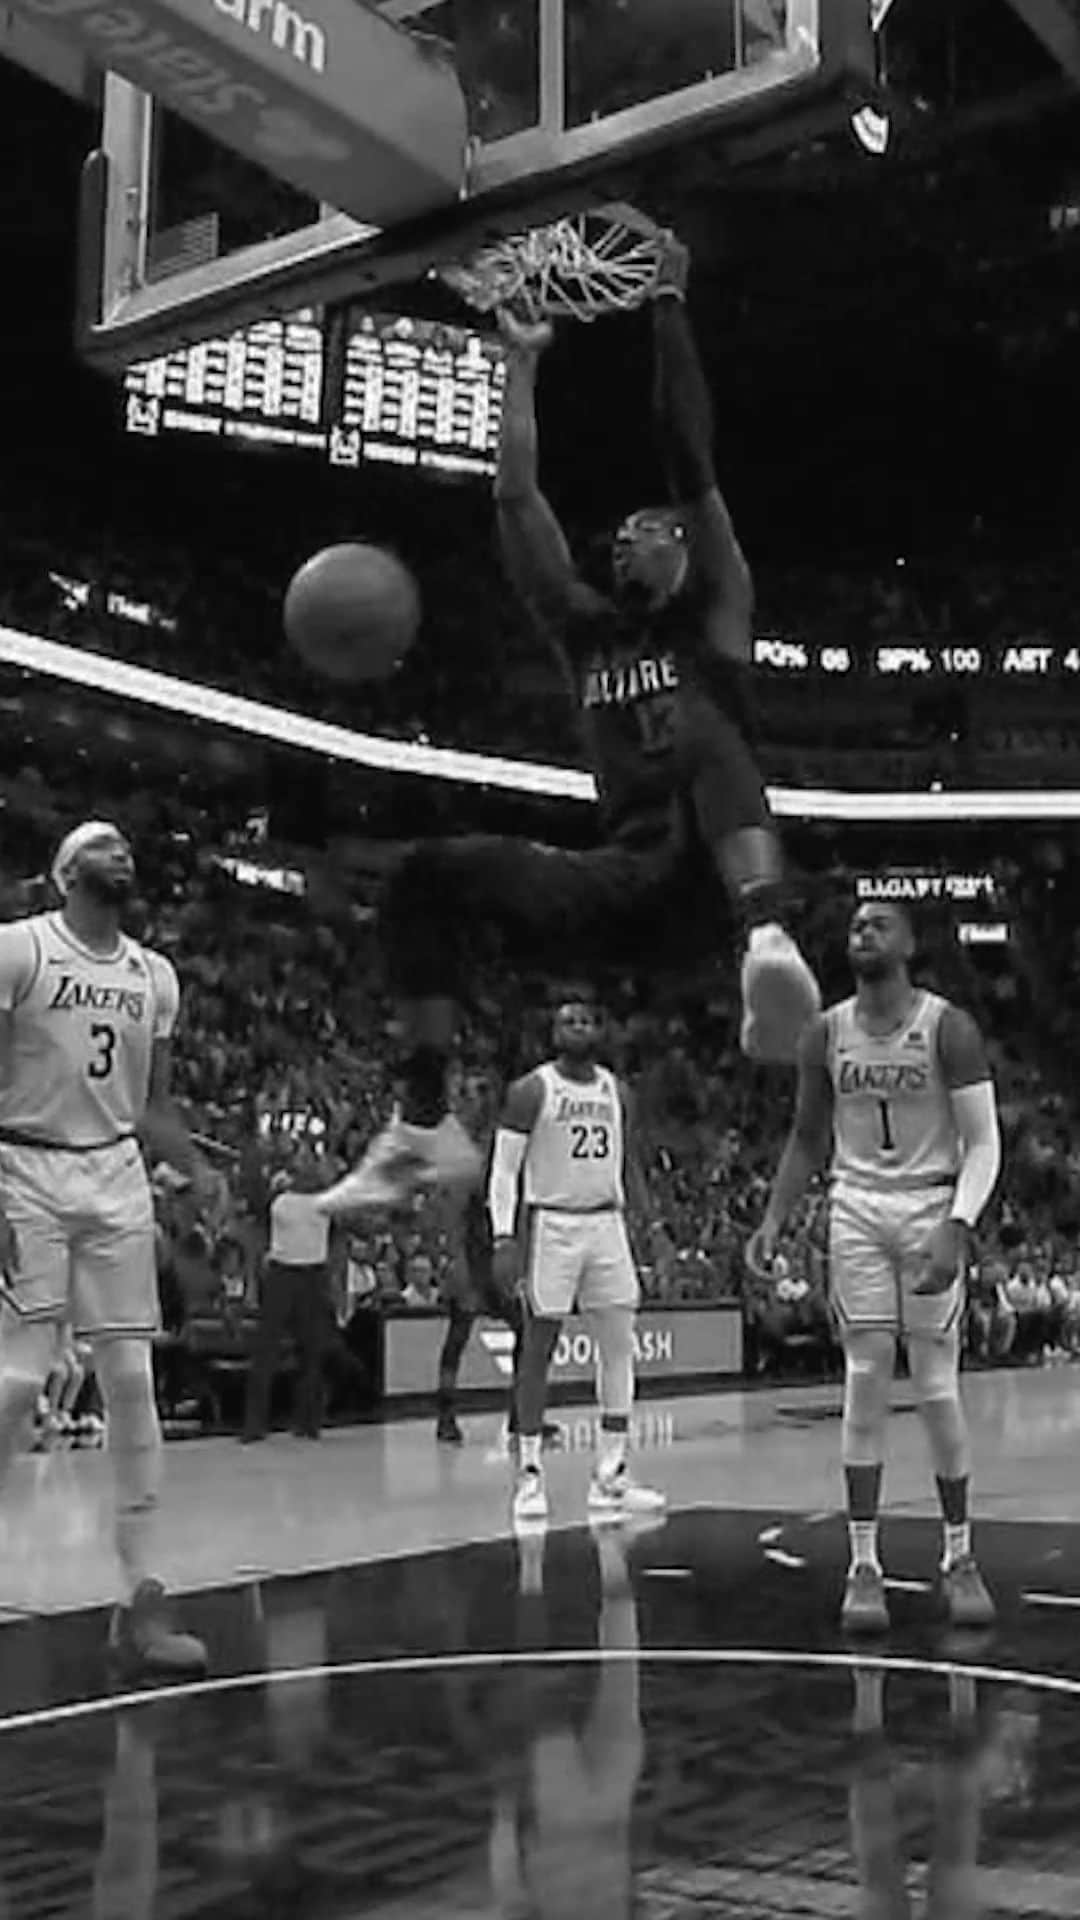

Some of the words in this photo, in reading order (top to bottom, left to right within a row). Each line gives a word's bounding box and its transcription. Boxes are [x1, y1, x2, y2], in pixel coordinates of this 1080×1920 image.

[940, 648, 980, 671] 100
[1003, 648, 1053, 672] AST
[49, 976, 144, 1024] LAKERS
[88, 1023, 116, 1079] 3
[571, 1125, 609, 1159] 23
[878, 1100, 895, 1150] 1
[552, 1331, 673, 1366] OOASH
